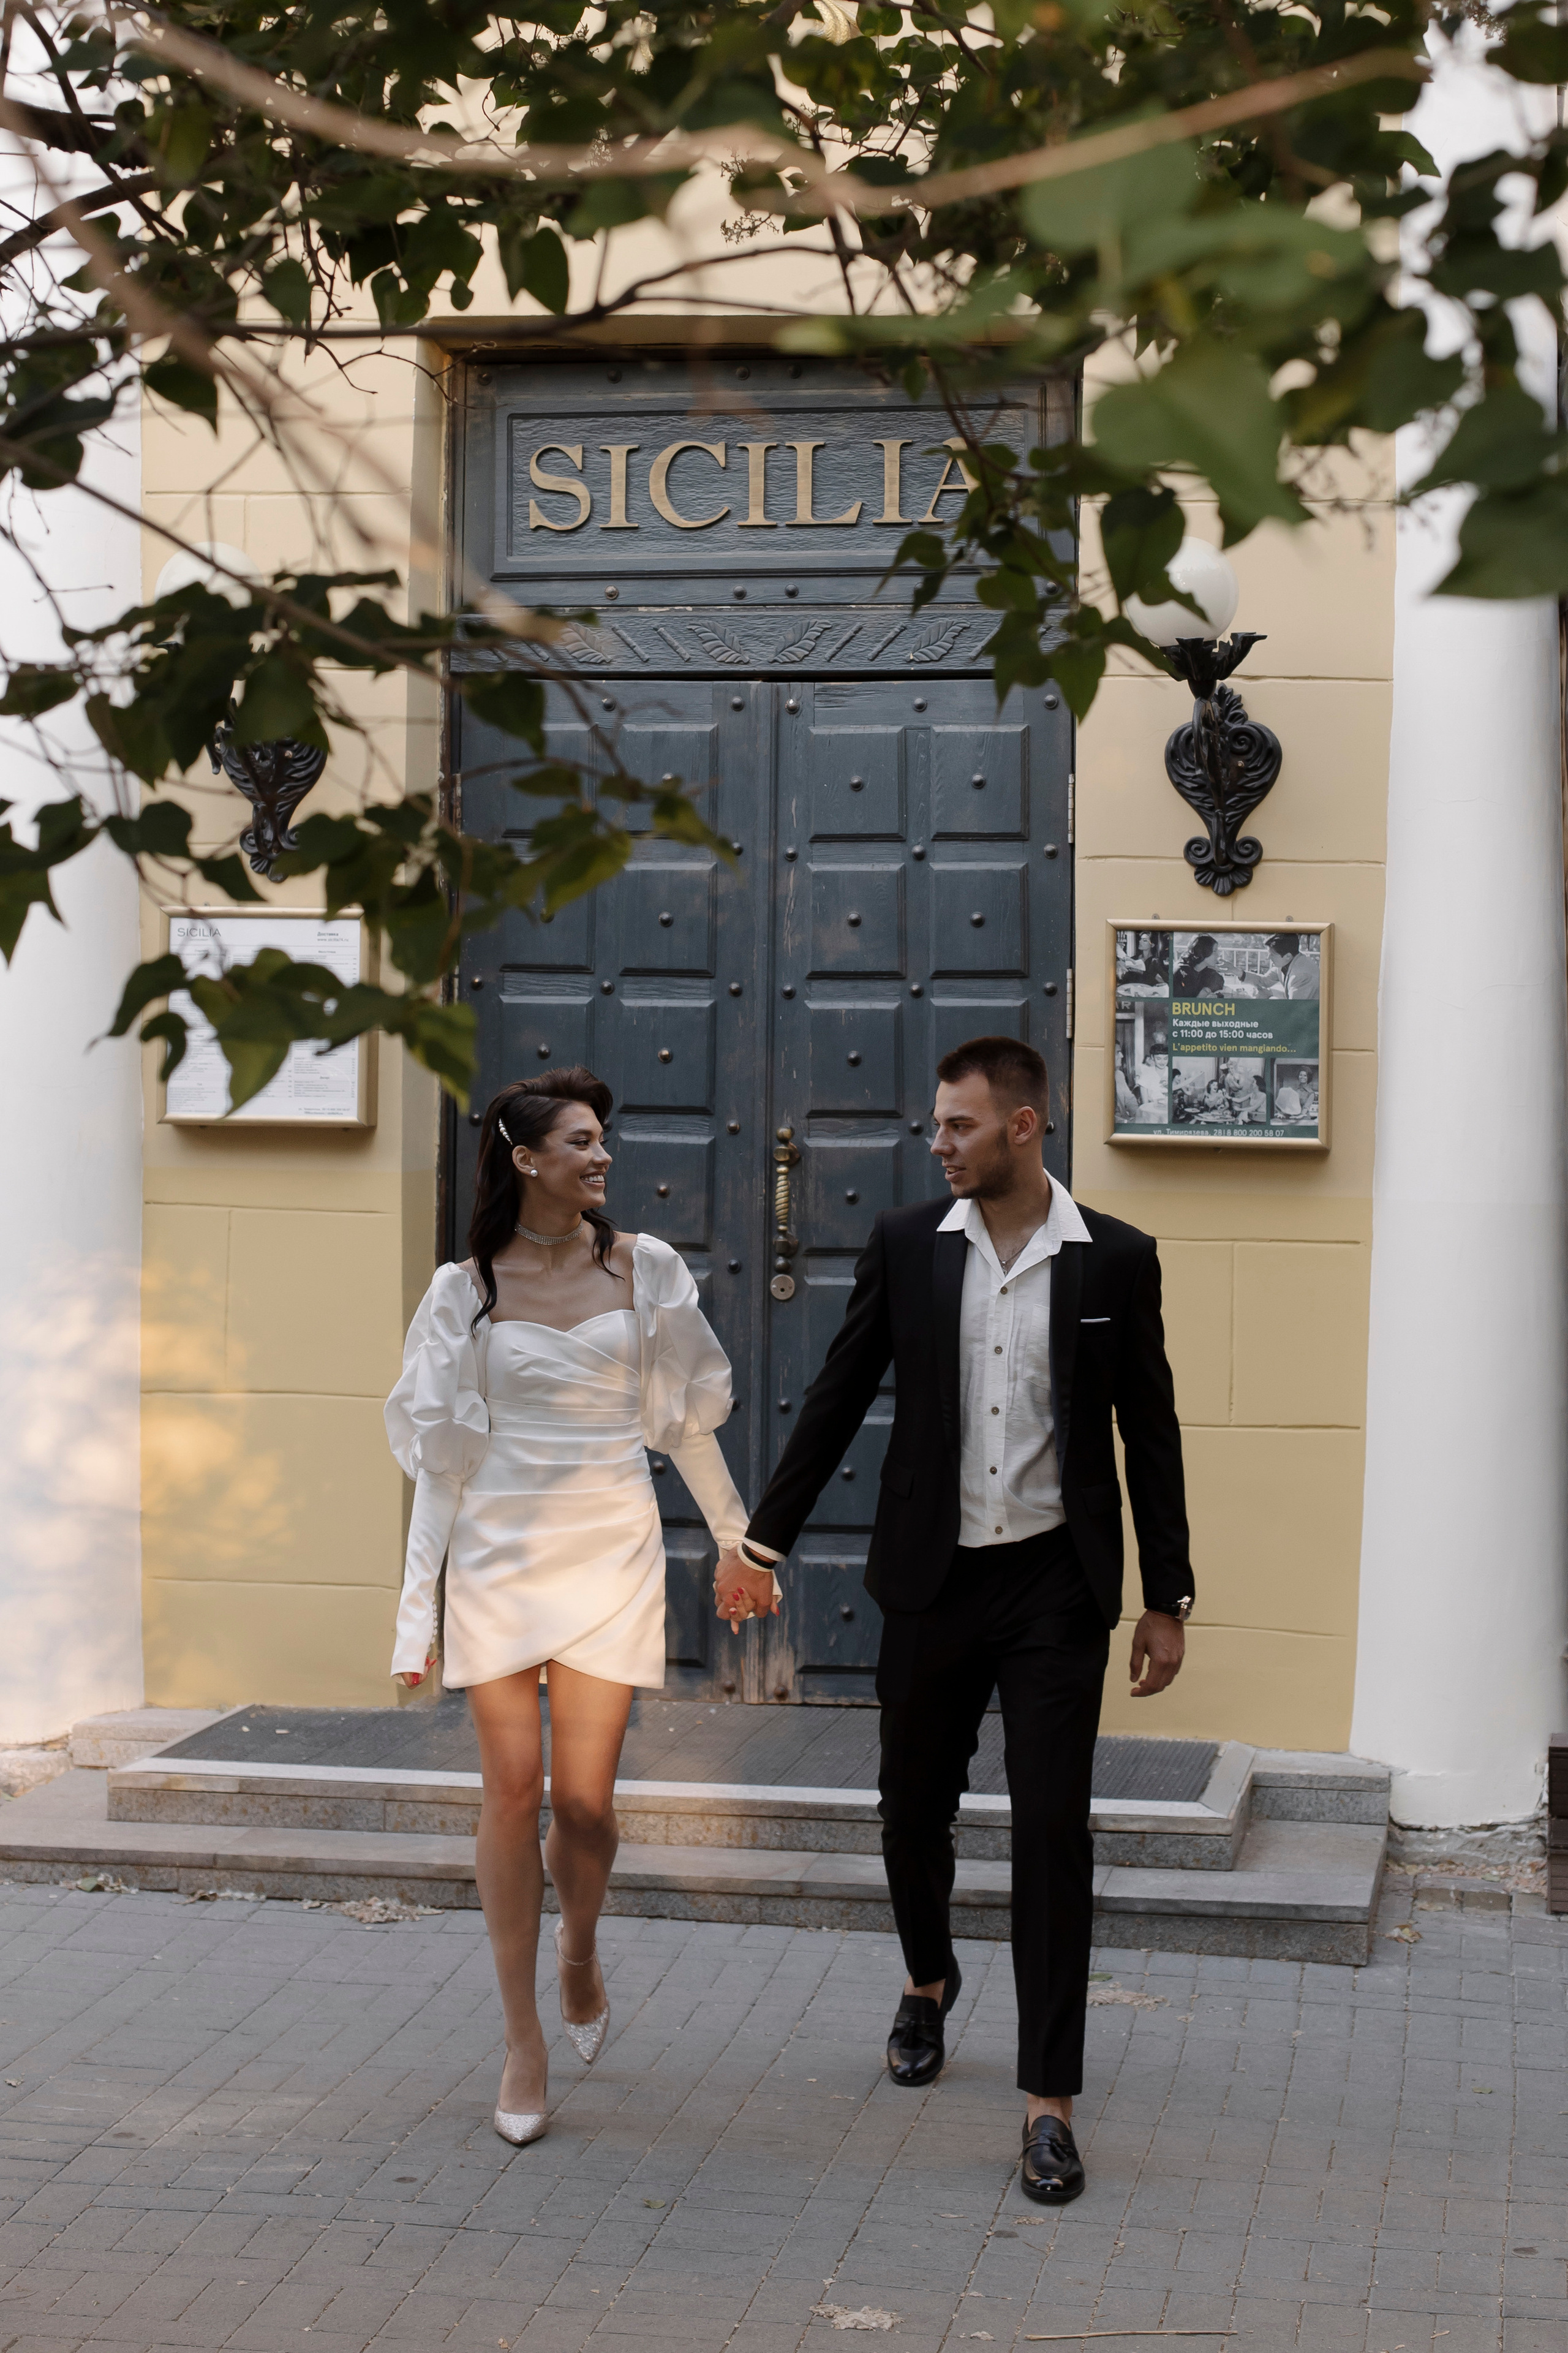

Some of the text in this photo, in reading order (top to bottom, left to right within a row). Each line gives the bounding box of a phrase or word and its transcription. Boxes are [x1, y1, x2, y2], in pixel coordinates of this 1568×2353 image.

[529, 436, 981, 531] SICILIA
[177, 927, 222, 937] SICILIA
[1172, 1002, 1235, 1016] BRUNCH
[1172, 1018, 1210, 1028] Каждые
[1180, 1029, 1204, 1038] 11:00
[1219, 1030, 1245, 1038] 15:00
[1219, 1043, 1238, 1052] vien
